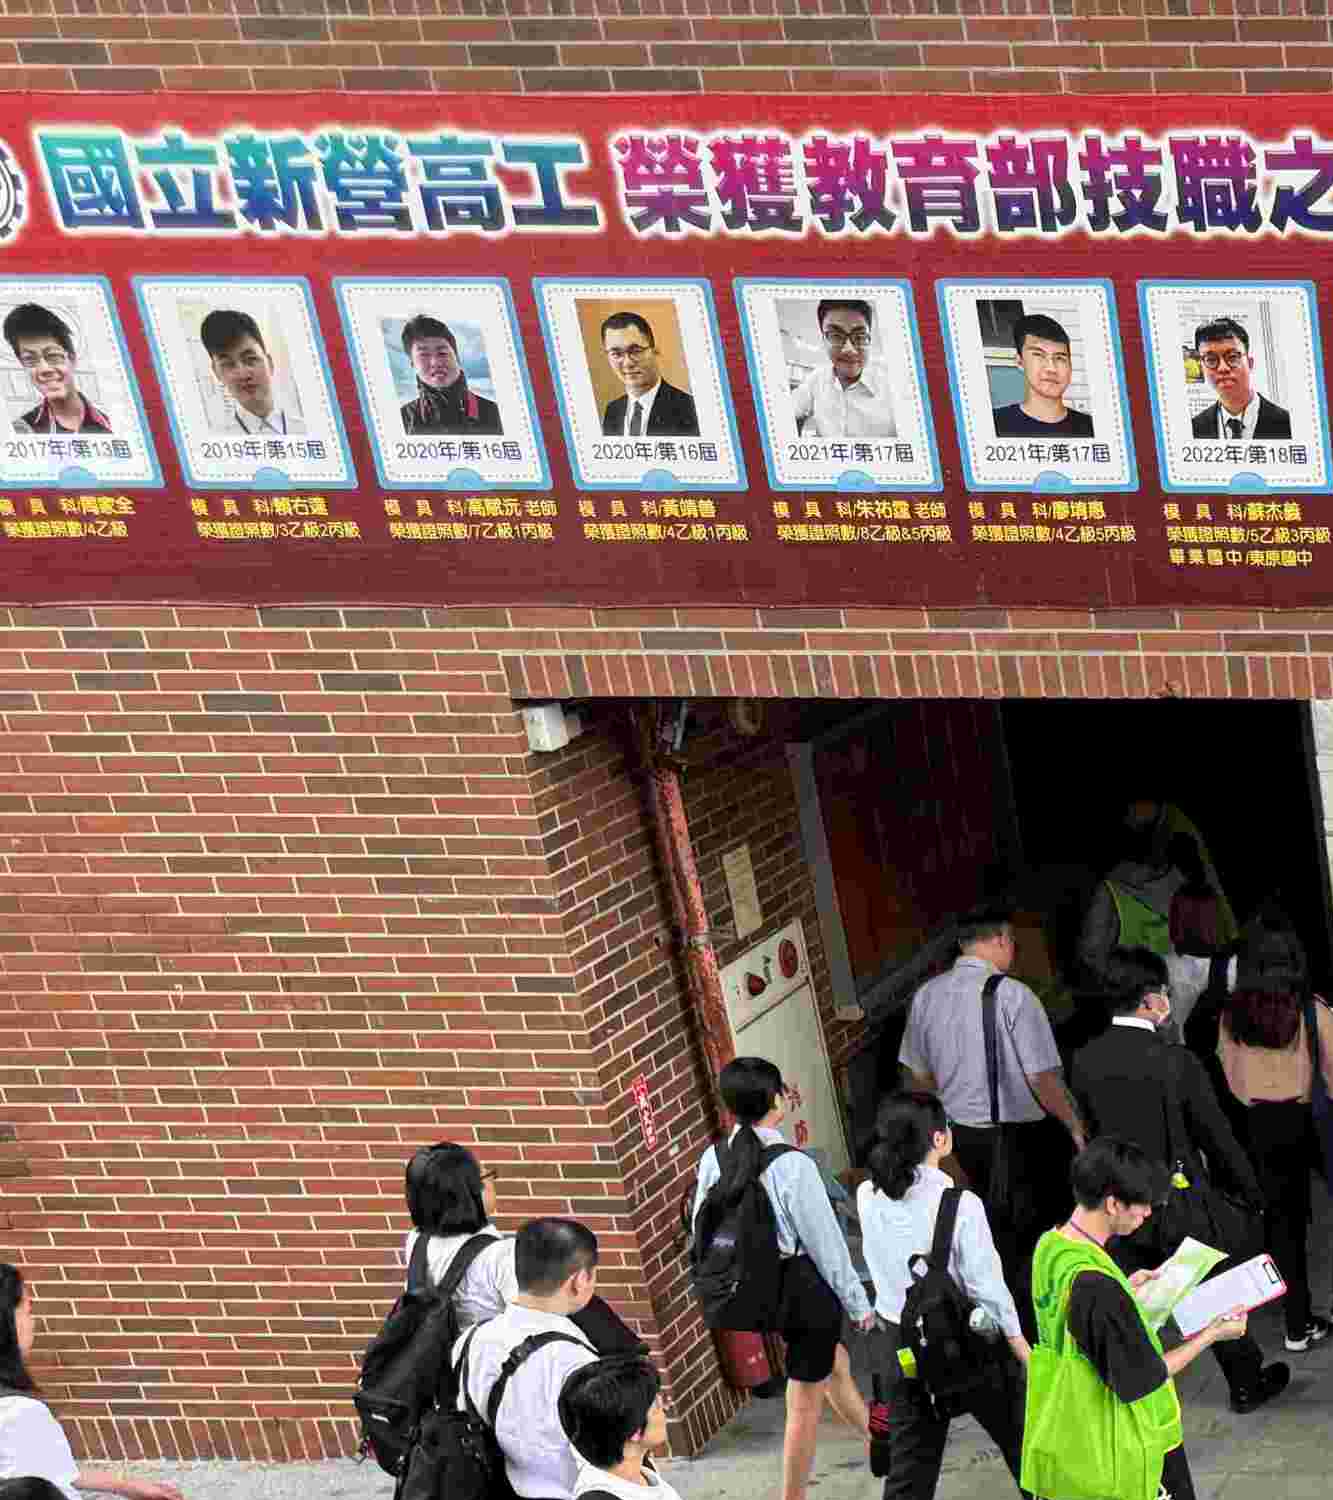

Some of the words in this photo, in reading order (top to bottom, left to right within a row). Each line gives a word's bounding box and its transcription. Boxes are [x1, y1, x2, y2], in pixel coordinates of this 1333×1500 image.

[36, 130, 602, 232] 國立新營高工
[6, 440, 132, 459] 2017年/第13屆
[200, 440, 327, 460] 2019年/第15屆
[396, 441, 522, 461] 2020年/第16屆
[591, 442, 718, 462] 2020年/第16屆
[788, 443, 914, 463] 2021年/第17屆
[984, 443, 1111, 464] 2021年/第17屆
[1182, 444, 1308, 465] 2022年/第18屆
